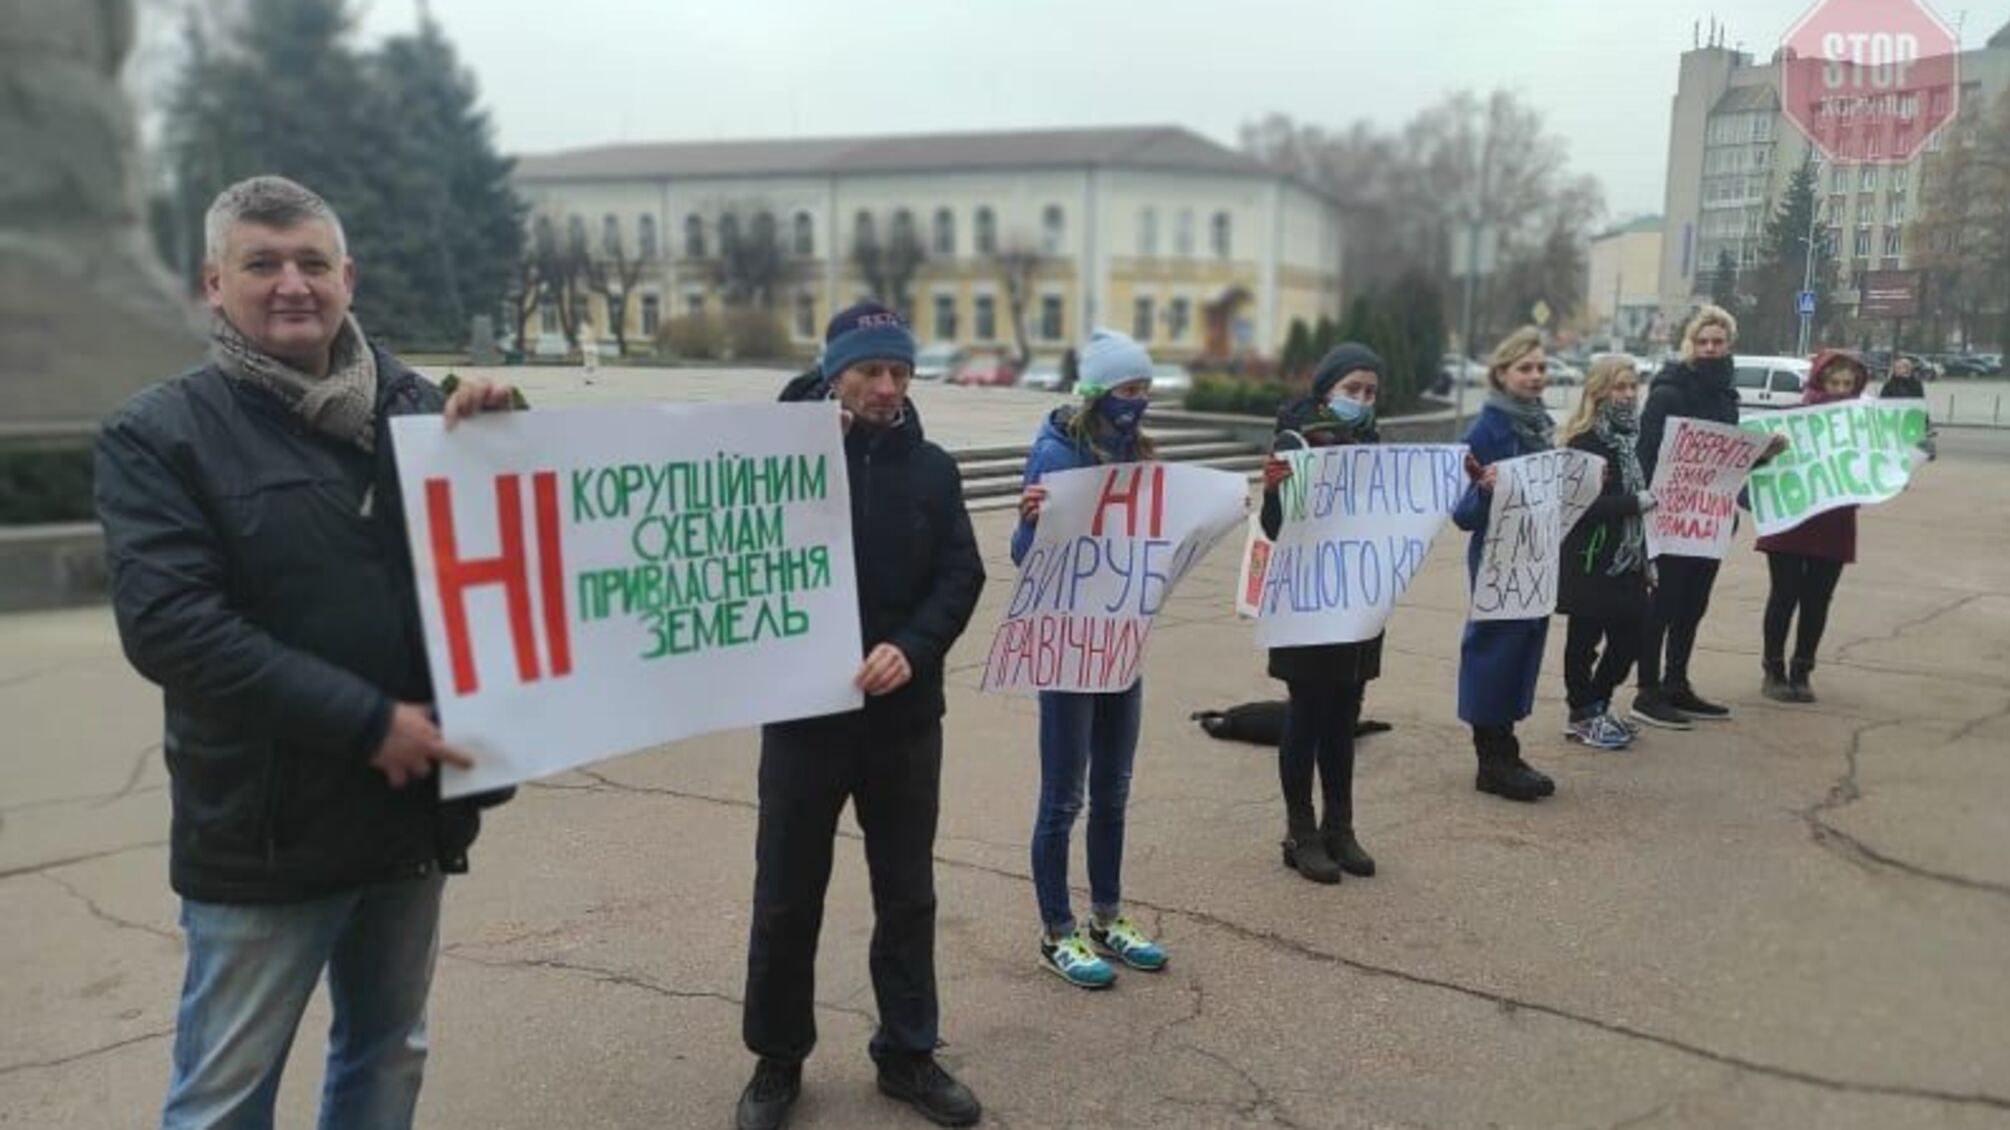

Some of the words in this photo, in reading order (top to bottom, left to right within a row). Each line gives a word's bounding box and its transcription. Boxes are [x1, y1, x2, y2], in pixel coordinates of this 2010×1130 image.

[571, 451, 827, 522] КОРУПЦІЙНИМ
[1091, 464, 1164, 537] НІ
[632, 505, 784, 563] СХЕМАМ
[424, 470, 572, 697] НІ
[577, 546, 831, 622] ПРИВЛАСНЕННЯ
[640, 595, 810, 660] ЗЕМЕЛЬ
